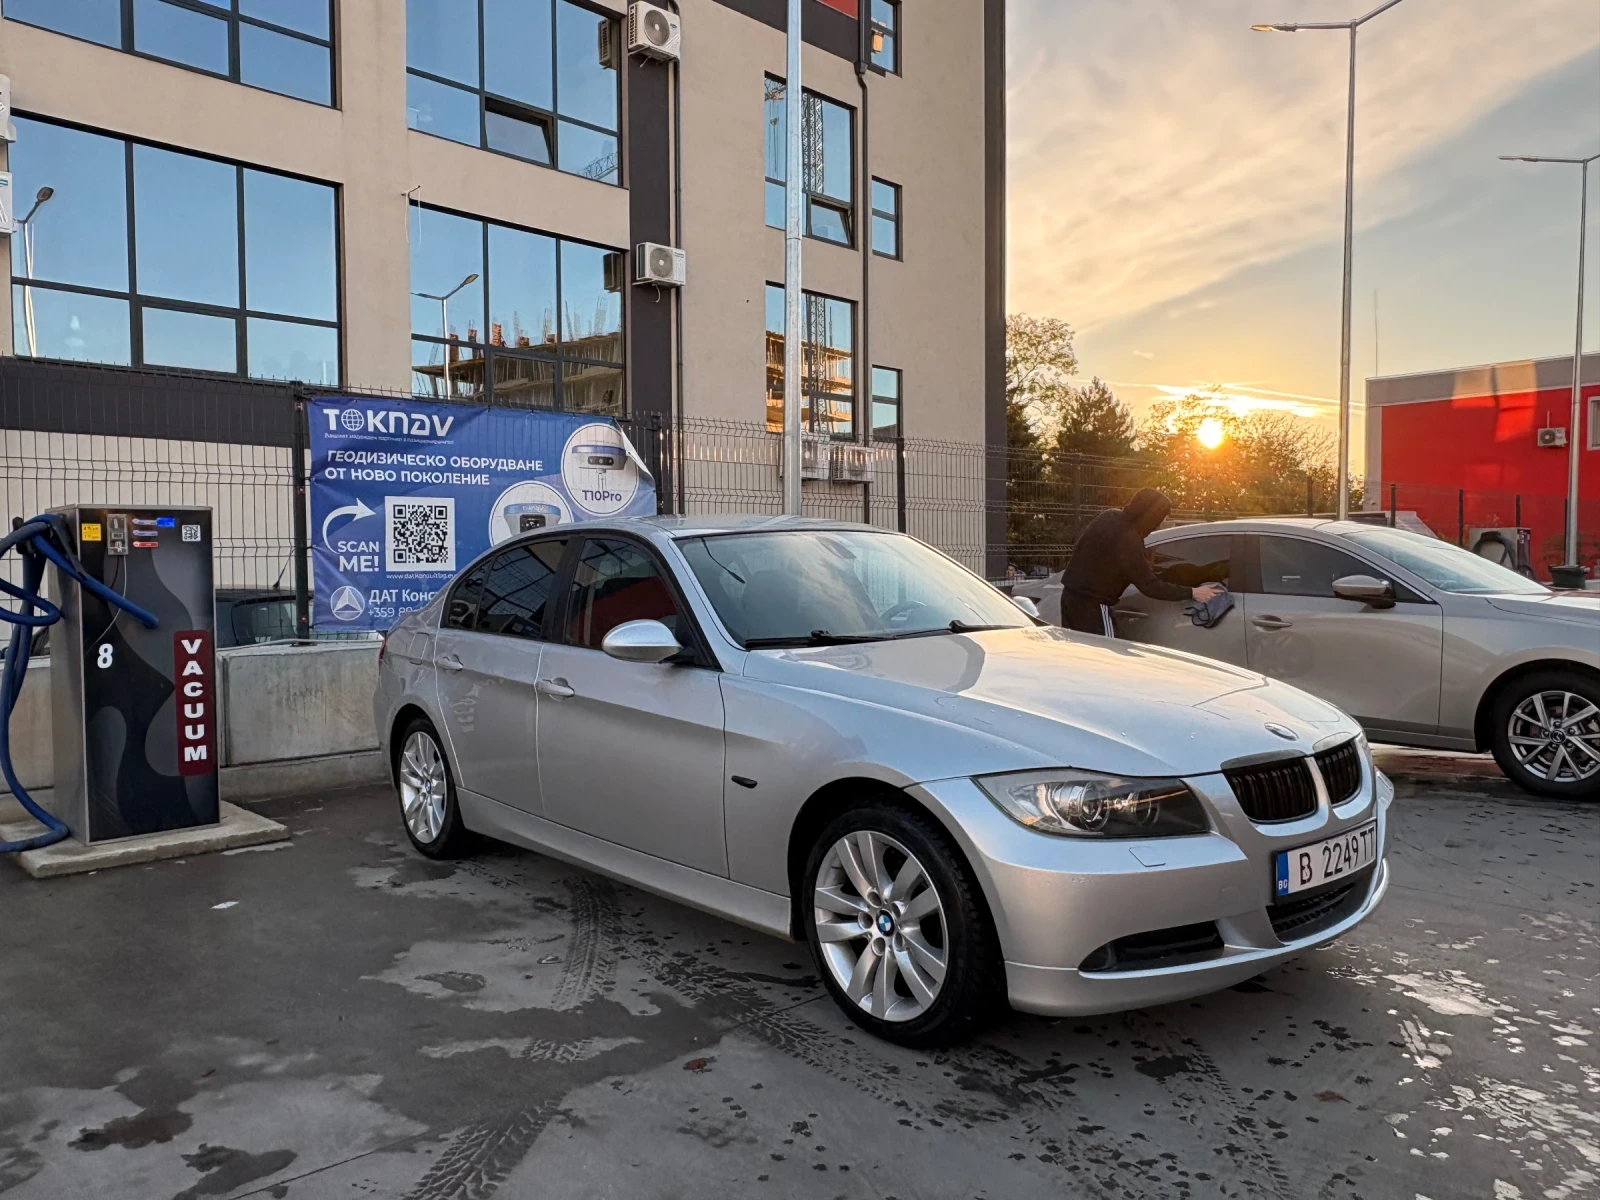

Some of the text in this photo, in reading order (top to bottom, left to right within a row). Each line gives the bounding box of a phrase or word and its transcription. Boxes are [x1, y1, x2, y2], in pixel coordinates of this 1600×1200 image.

[327, 450, 544, 472] ГЕОДИЗИЧЕСКО ОБОРУДВАНЕ
[324, 467, 490, 486] ОТ НОВО ПОКОЛЕНИЕ
[582, 490, 622, 502] T10Pro
[337, 541, 379, 553] SCAN
[339, 555, 379, 573] ME!
[368, 589, 398, 605] ДАТ
[368, 607, 395, 618] +359
[97, 643, 113, 669] 8
[181, 638, 207, 762] VACUUM
